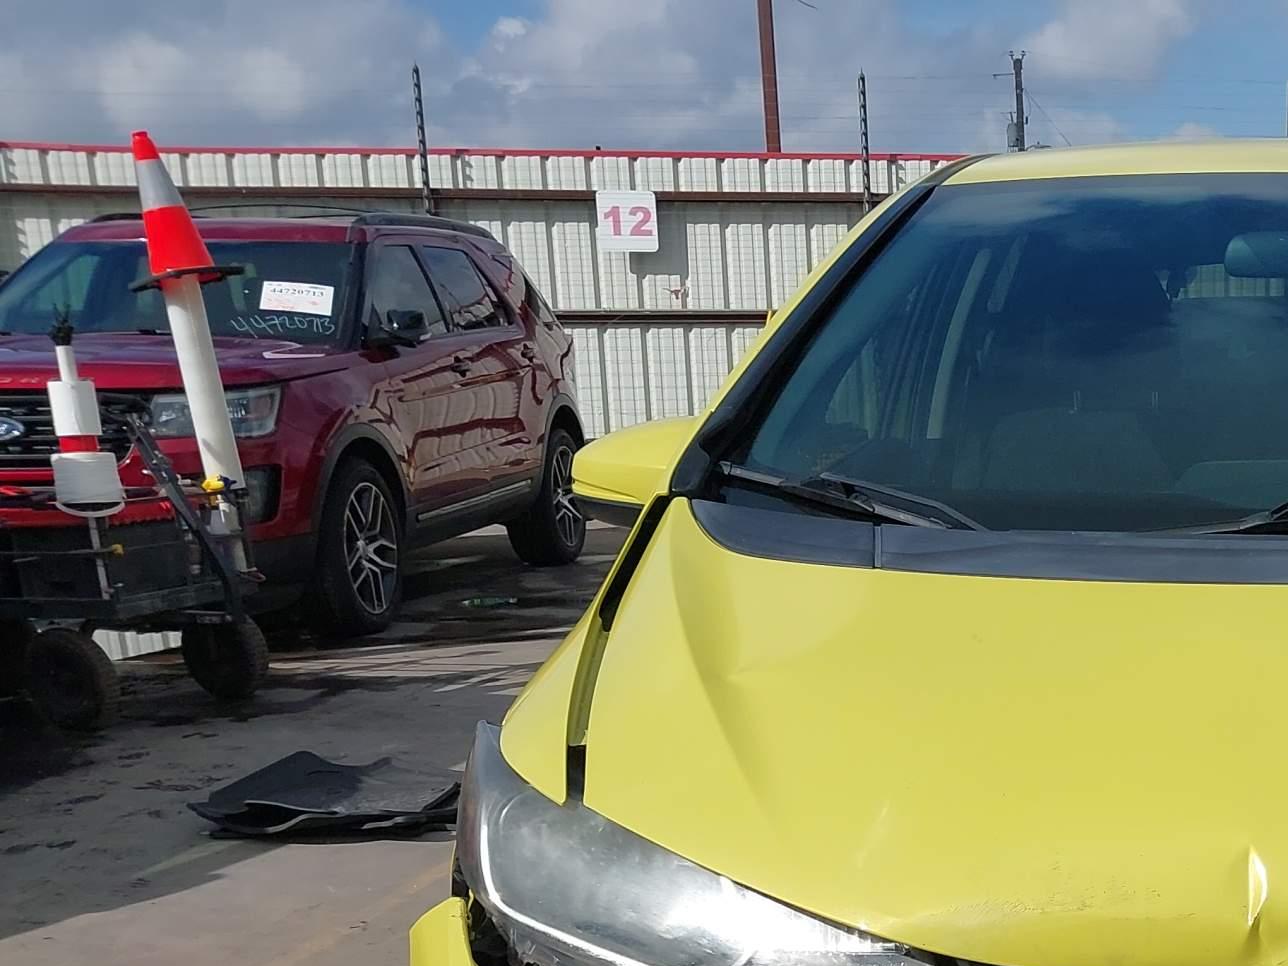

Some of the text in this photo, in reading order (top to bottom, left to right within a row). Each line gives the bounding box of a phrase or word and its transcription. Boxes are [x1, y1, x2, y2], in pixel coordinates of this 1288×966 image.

[603, 206, 653, 236] 12
[270, 287, 324, 297] 44720713
[230, 315, 336, 339] 44720713
